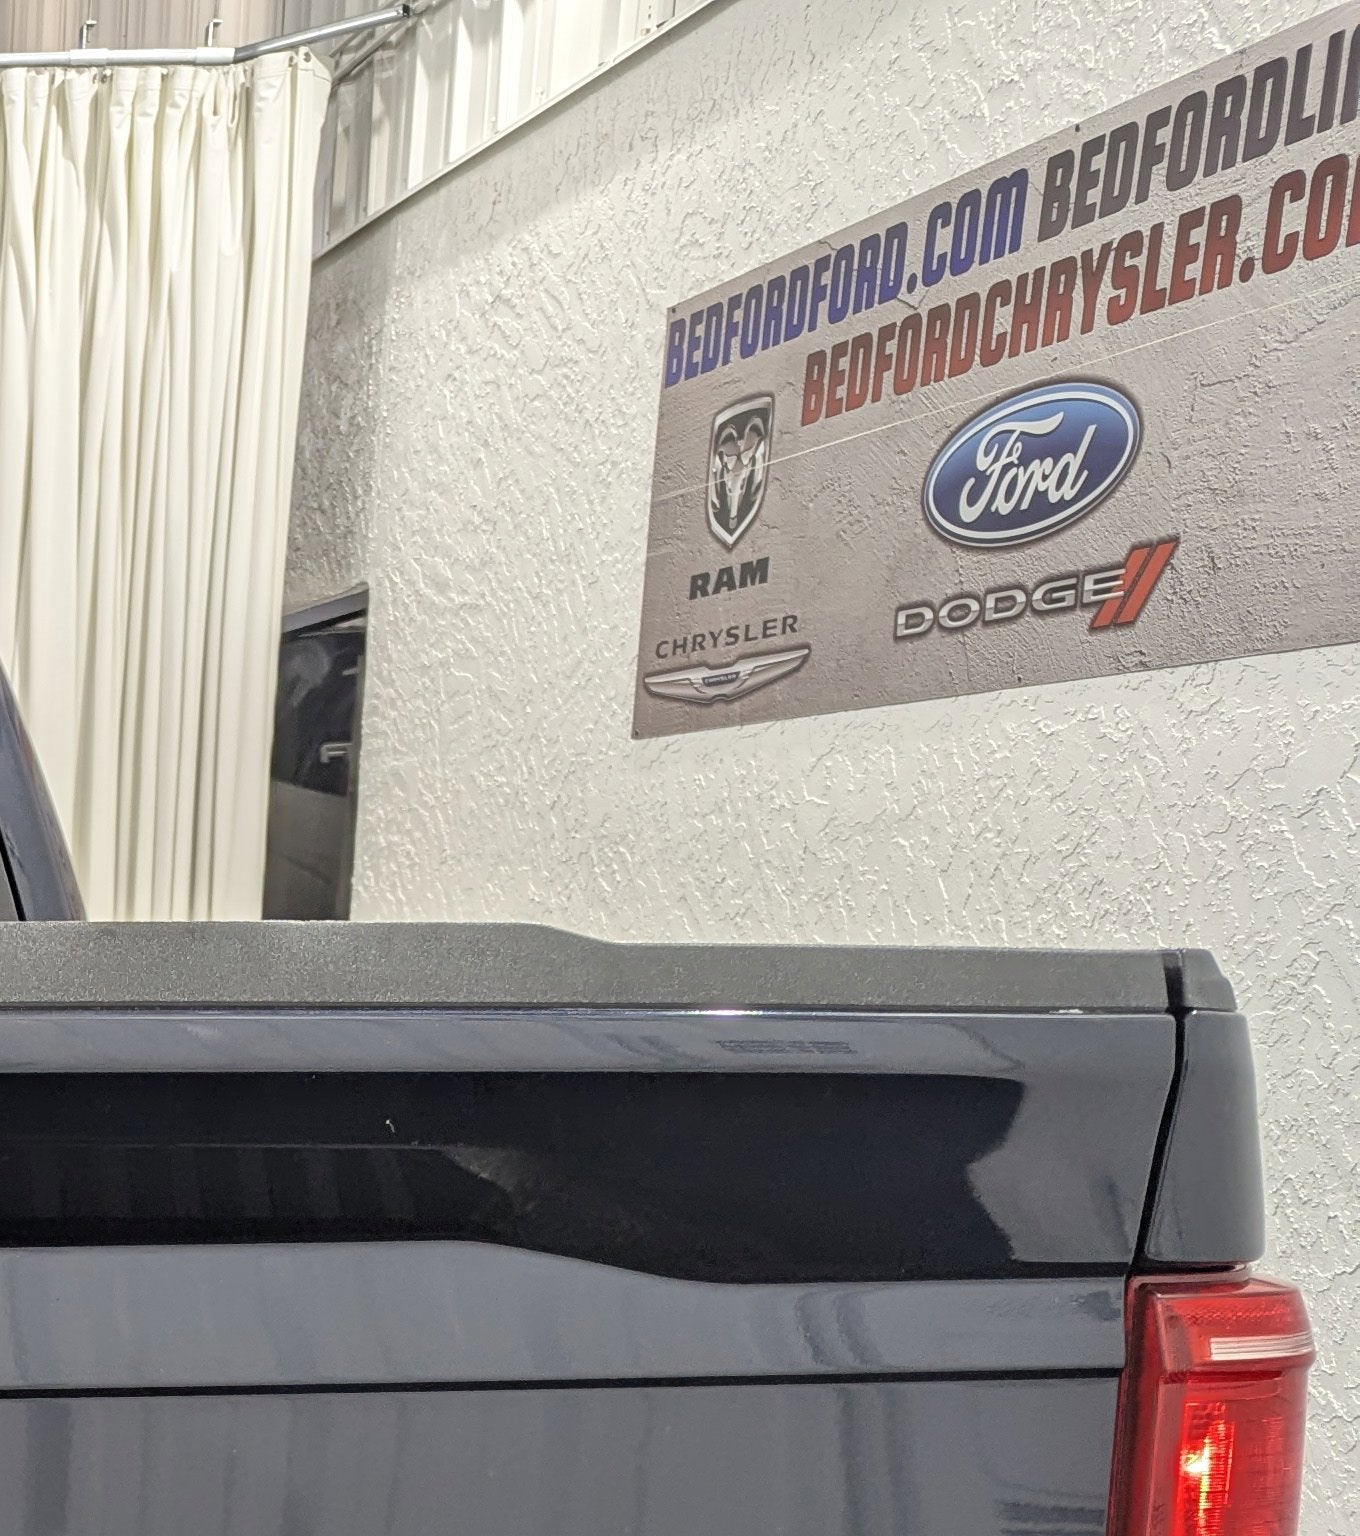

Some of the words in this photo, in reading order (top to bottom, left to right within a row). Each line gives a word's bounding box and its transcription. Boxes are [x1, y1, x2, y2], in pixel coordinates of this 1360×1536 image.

[665, 168, 1029, 390] BEDFORDFORD.COM
[801, 153, 1360, 427] BEDFORDCHRYSLER.CO
[959, 411, 1097, 523] Ford
[689, 556, 769, 600] RAM
[895, 568, 1126, 637] DODGE
[655, 614, 798, 659] CHRYSLER
